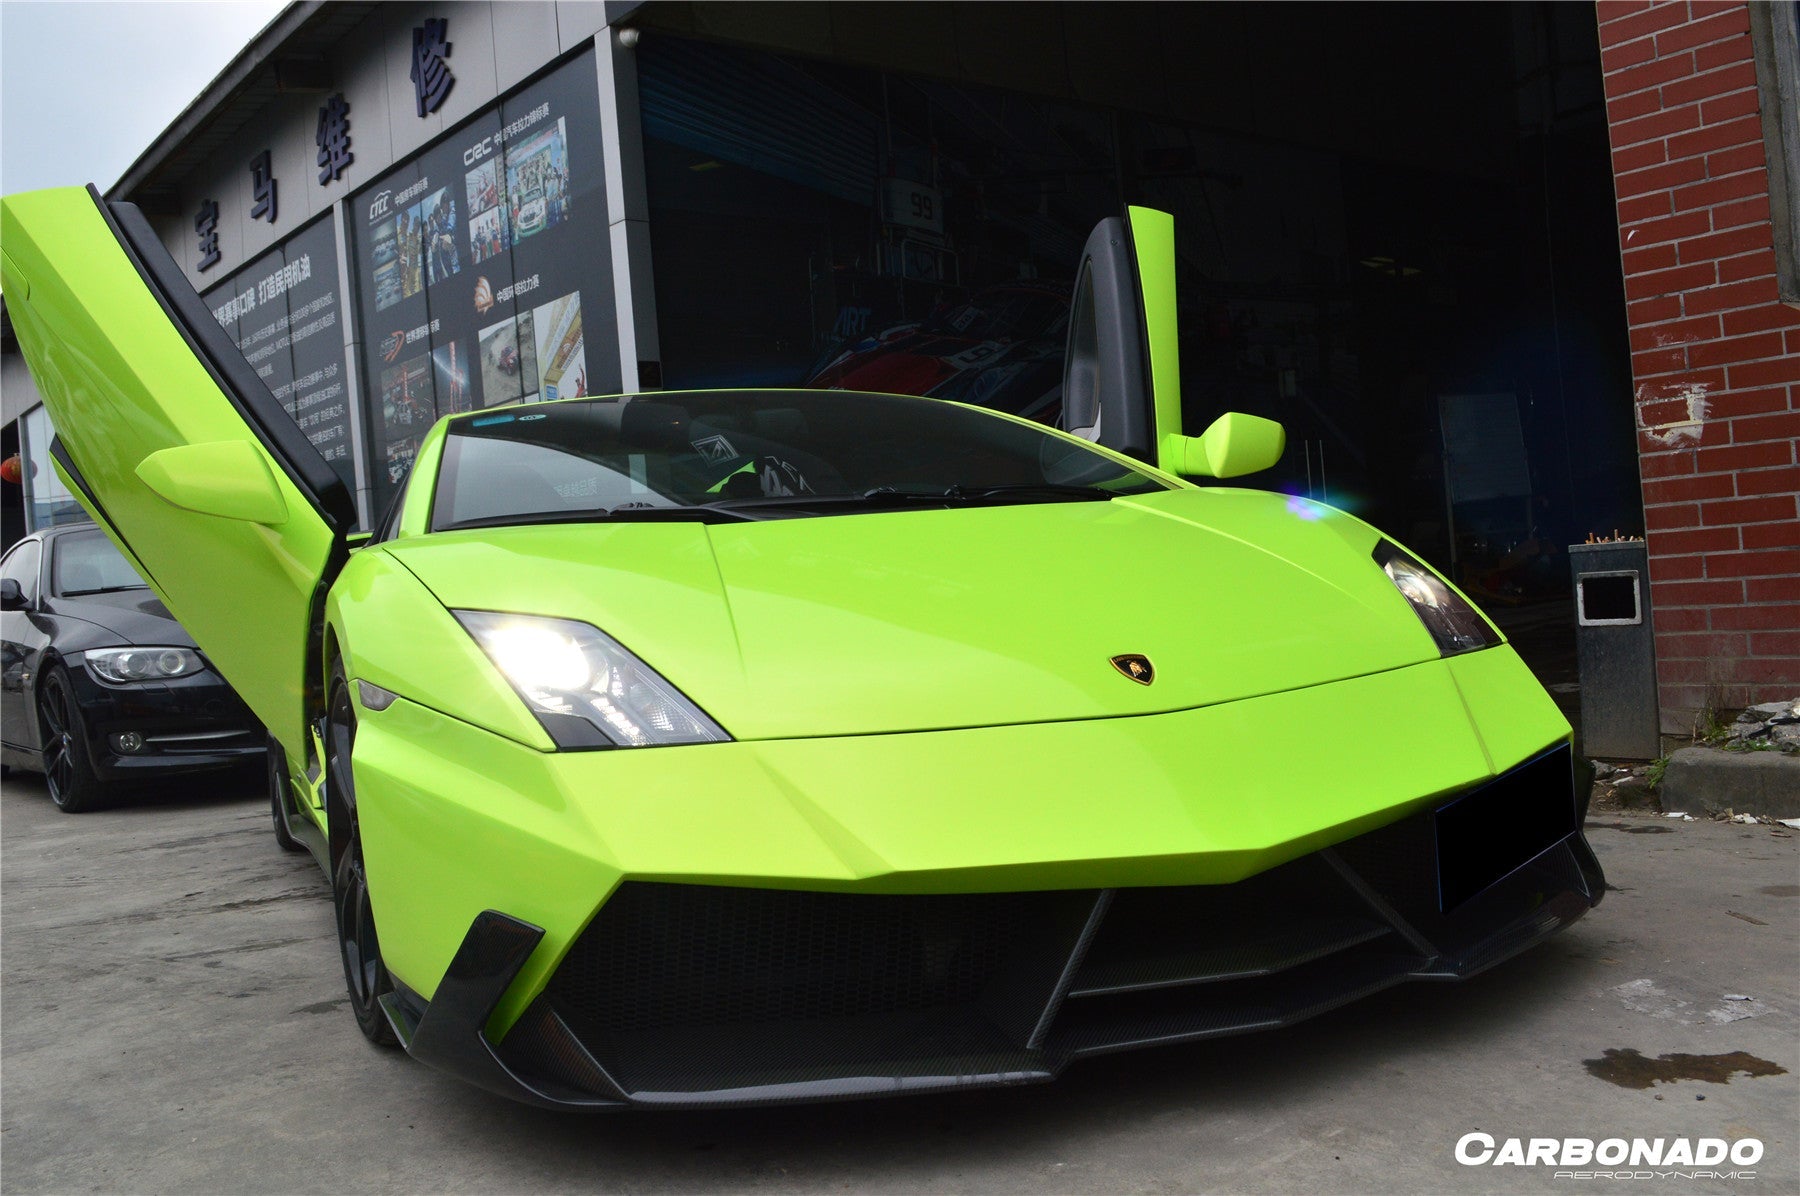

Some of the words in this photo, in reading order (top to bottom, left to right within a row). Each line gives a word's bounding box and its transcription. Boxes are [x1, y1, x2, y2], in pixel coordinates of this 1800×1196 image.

[195, 17, 456, 273] 宝马维修
[463, 139, 492, 166] CRC
[369, 195, 389, 220] CTCC
[911, 190, 933, 221] 99
